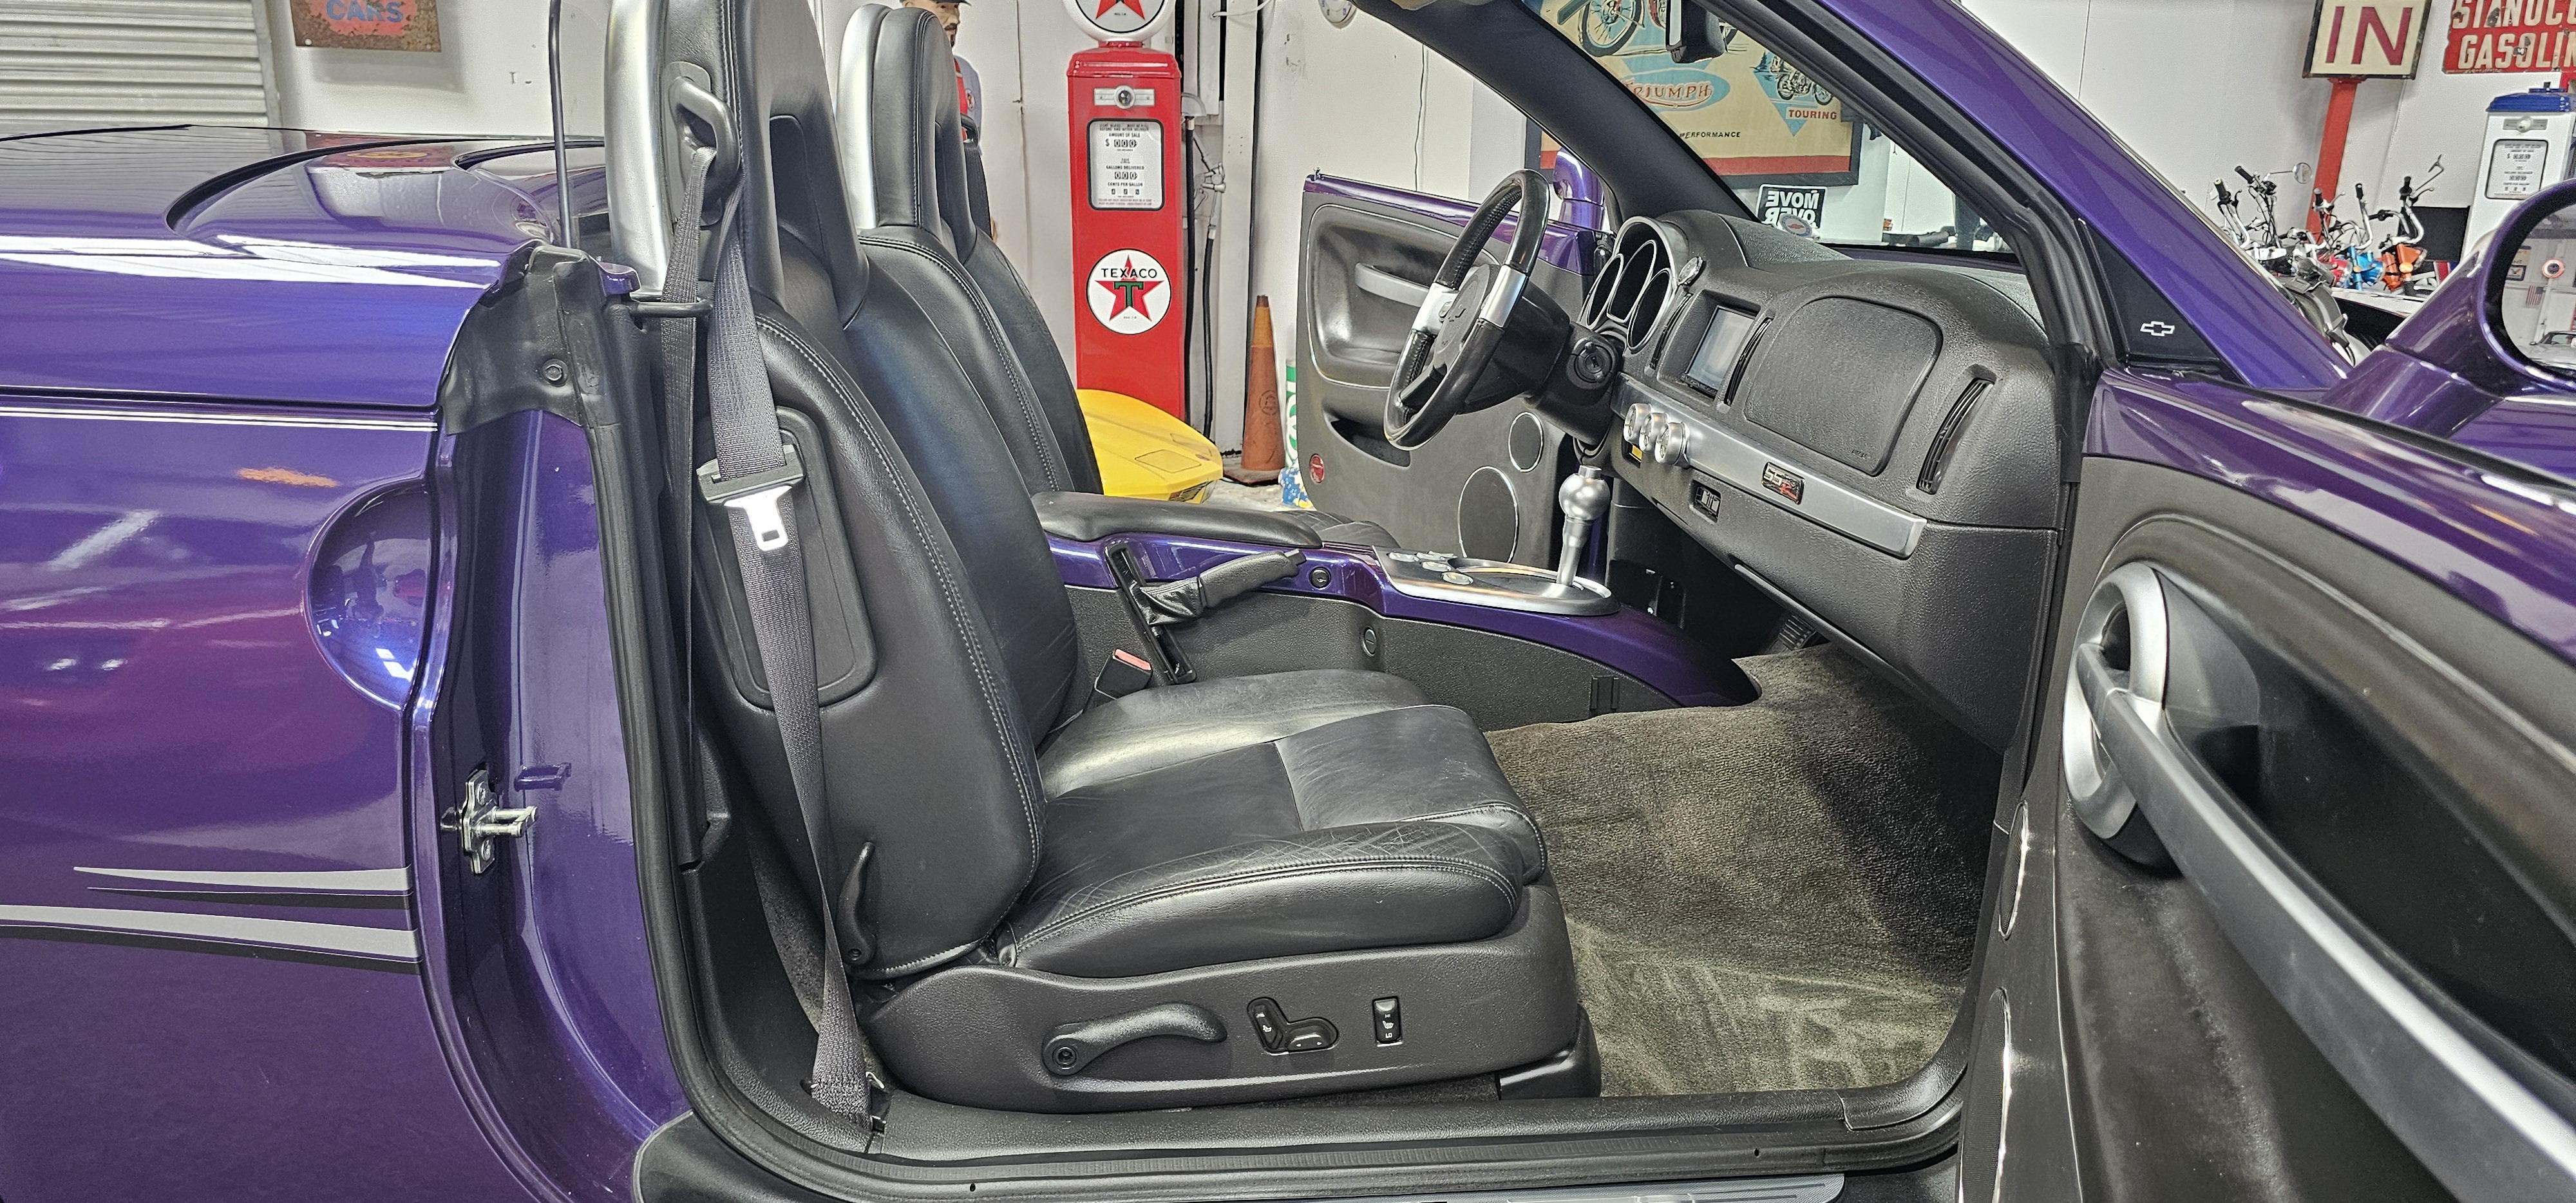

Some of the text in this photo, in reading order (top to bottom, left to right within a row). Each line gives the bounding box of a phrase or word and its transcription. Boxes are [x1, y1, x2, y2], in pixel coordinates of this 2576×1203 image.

[2325, 6, 2413, 66] IN
[1788, 109, 1837, 120] TOURING
[1101, 268, 1157, 278] TEXACO
